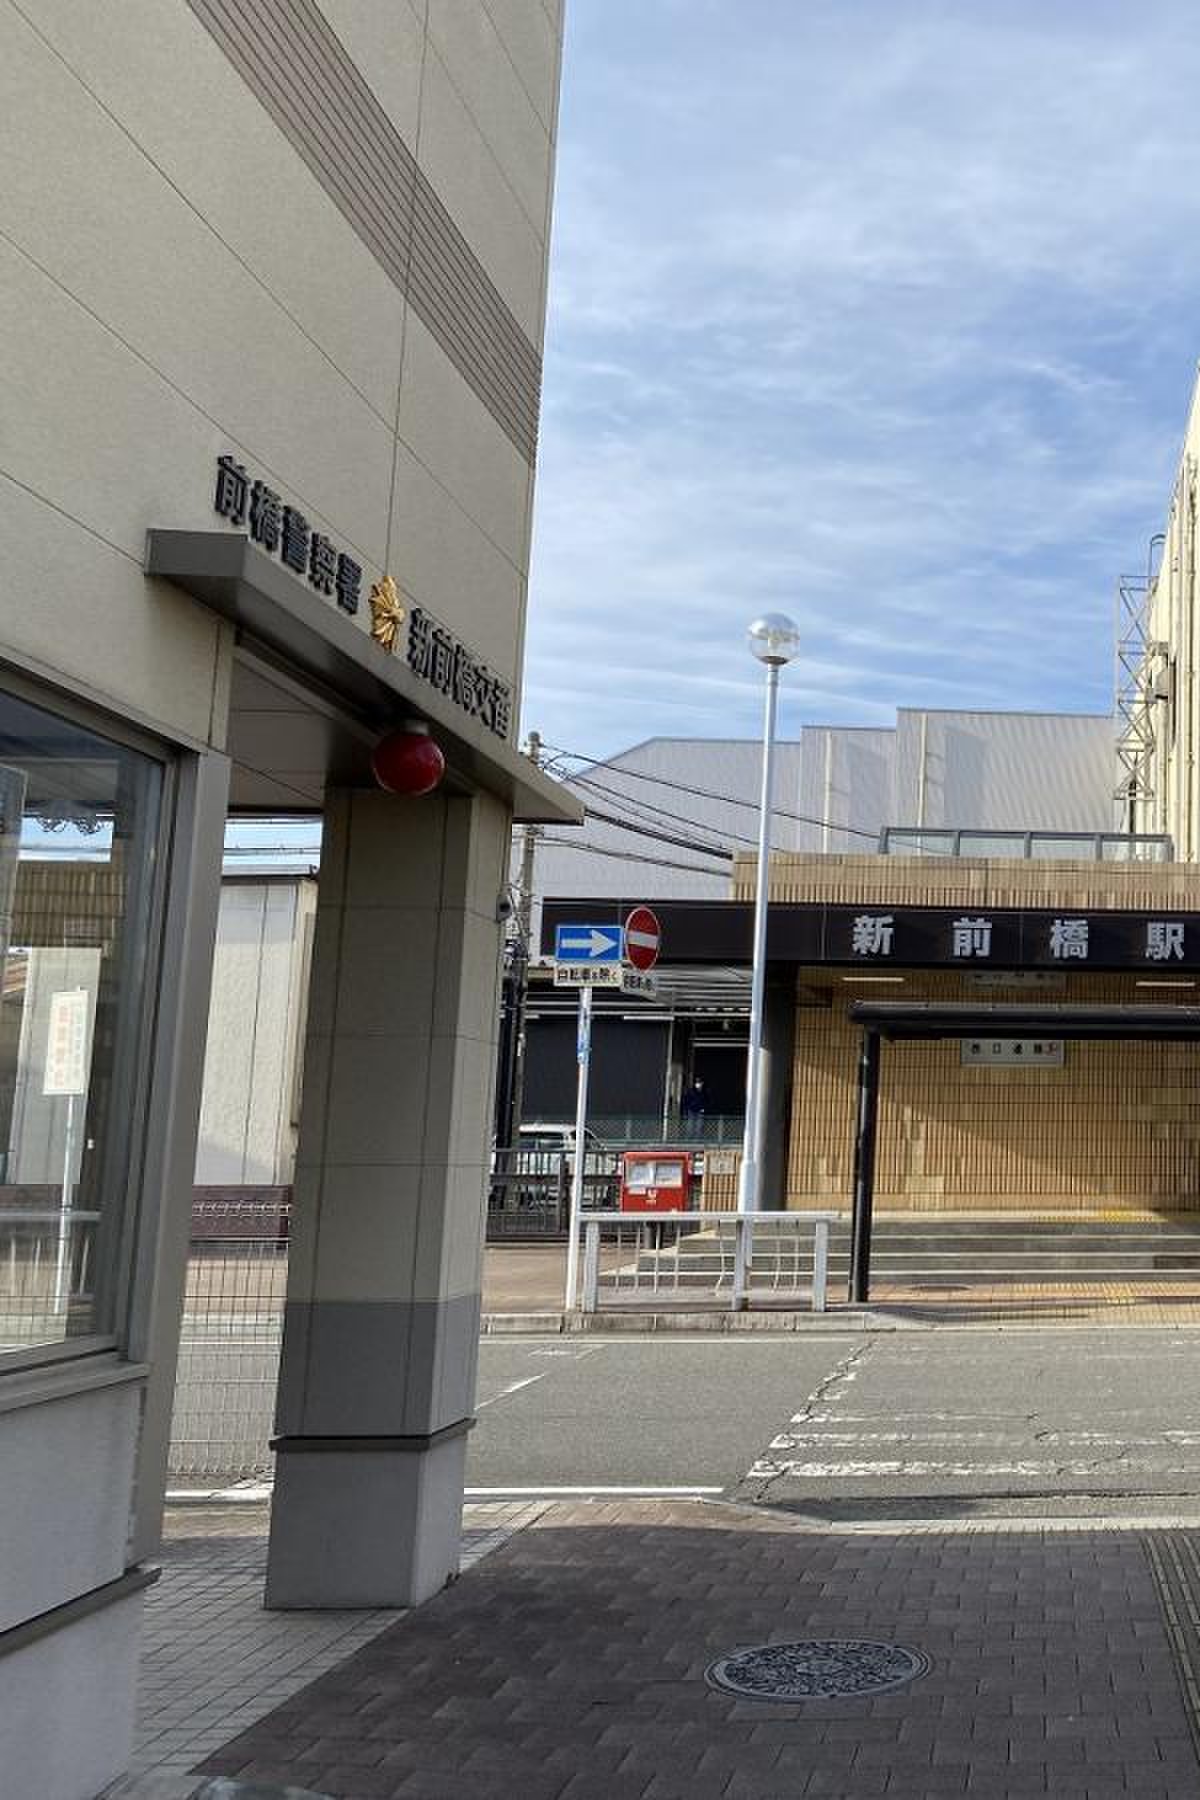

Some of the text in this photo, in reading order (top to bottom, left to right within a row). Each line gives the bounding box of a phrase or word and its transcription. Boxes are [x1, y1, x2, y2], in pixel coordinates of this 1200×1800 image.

[214, 455, 363, 616] 前橋警察署
[852, 915, 1185, 961] 新前橋駅
